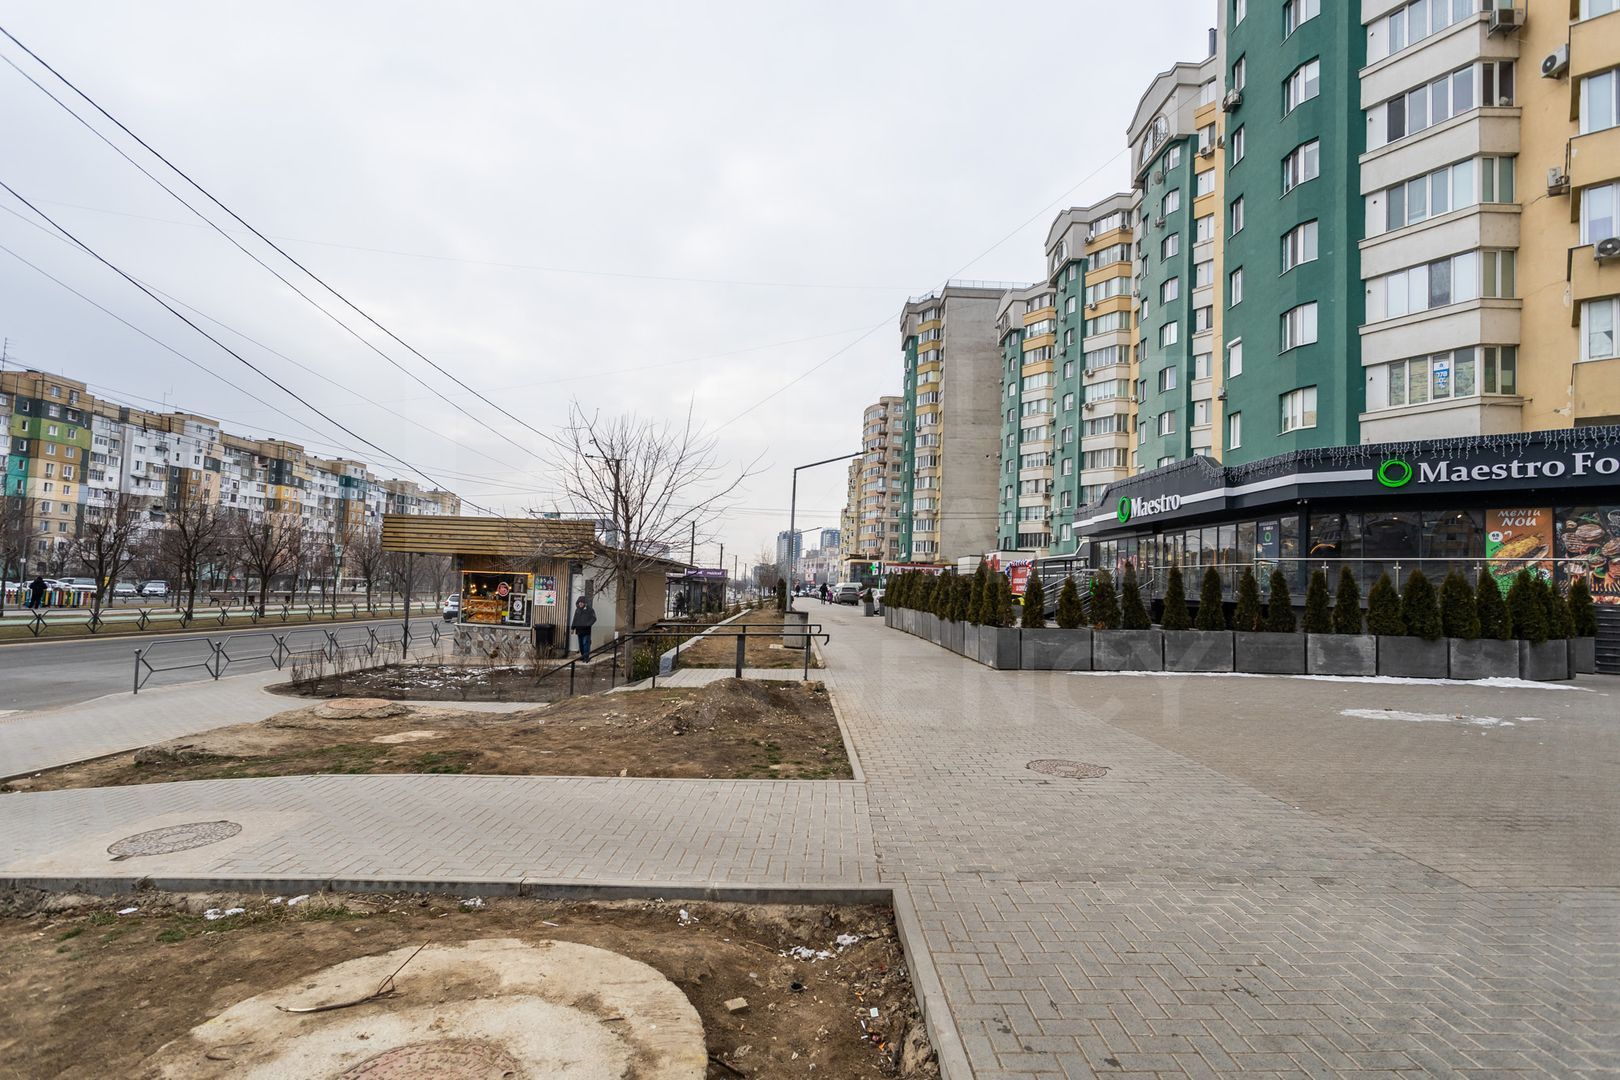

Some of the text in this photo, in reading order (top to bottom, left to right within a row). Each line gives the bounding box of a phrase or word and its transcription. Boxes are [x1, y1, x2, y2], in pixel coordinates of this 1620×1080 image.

[1418, 451, 1620, 484] Maestro Fo
[1131, 494, 1181, 519] Maestro
[1501, 517, 1537, 527] NOU
